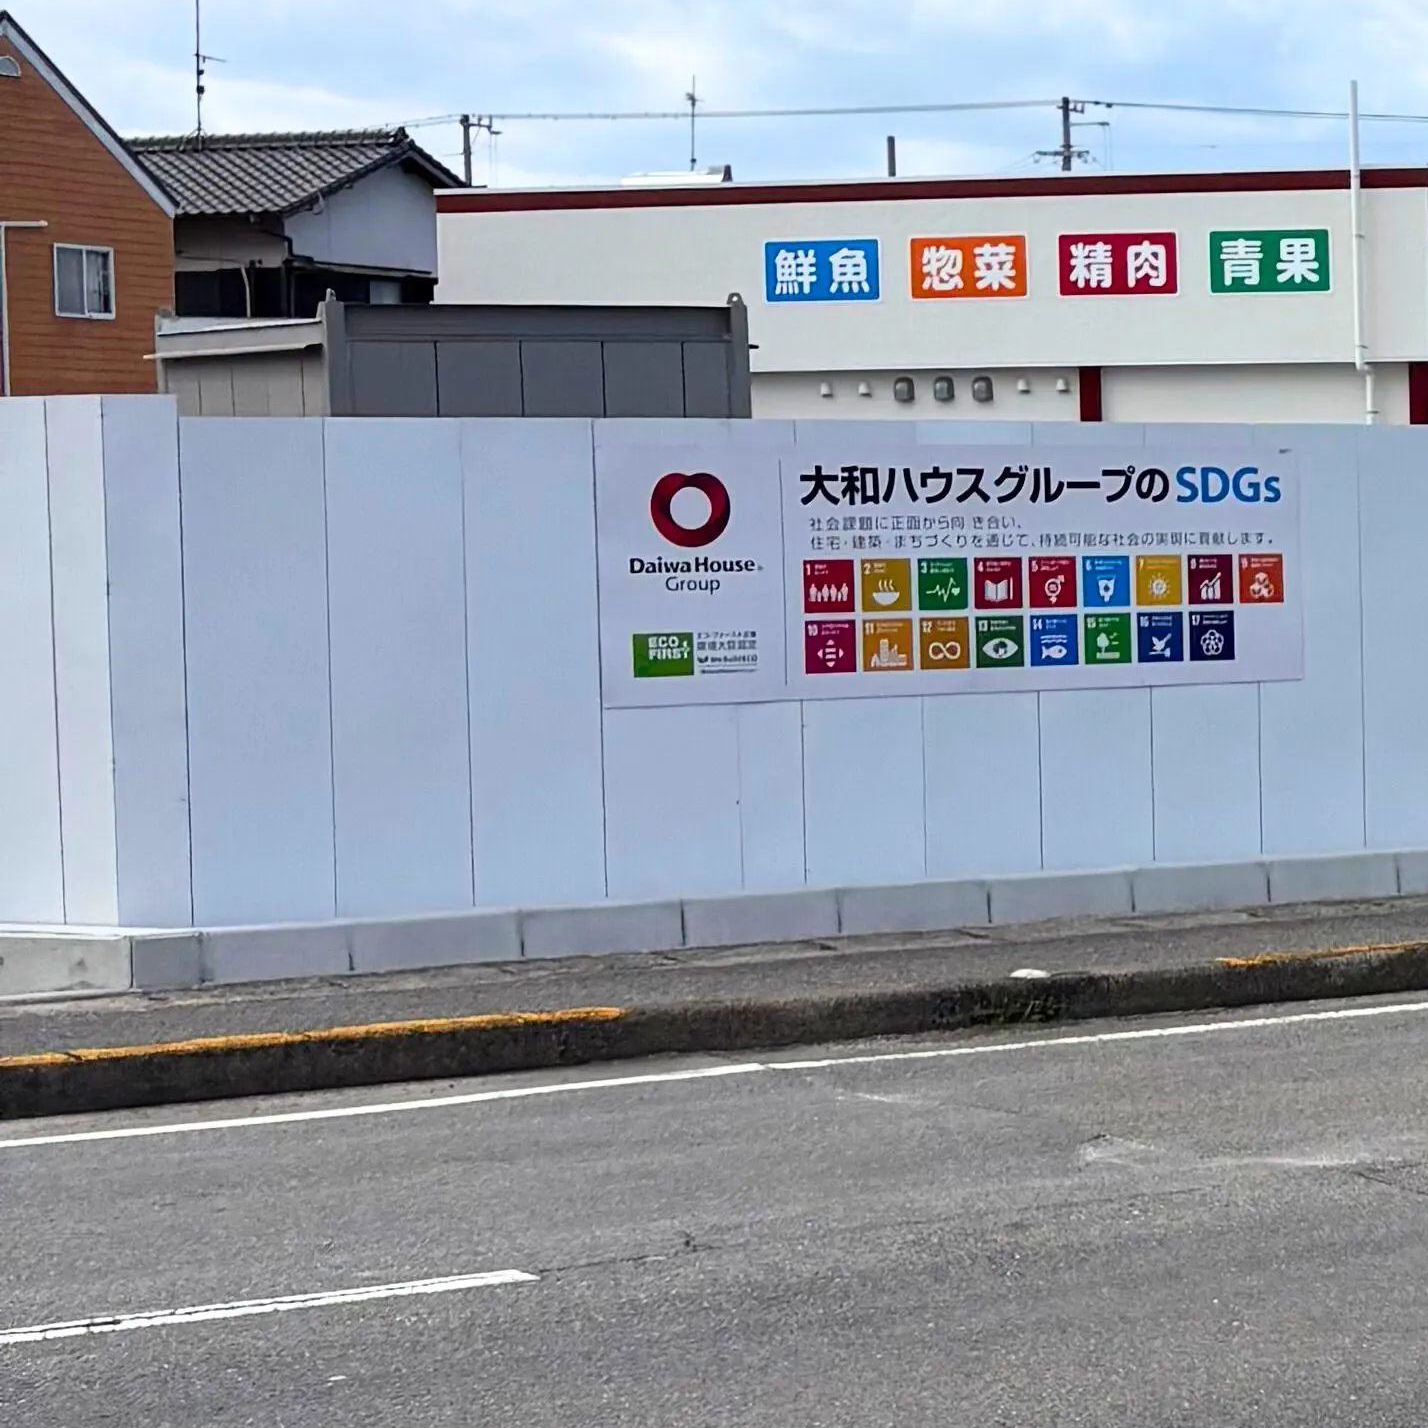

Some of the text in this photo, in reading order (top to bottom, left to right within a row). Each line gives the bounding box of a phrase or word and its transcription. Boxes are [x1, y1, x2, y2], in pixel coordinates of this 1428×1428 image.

[921, 243, 1016, 292] 惣菜
[1069, 240, 1166, 288] 精肉
[1219, 238, 1319, 285] 青果
[774, 248, 869, 294] 鮮魚
[629, 556, 756, 573] Daiwa House
[806, 564, 811, 575] 1
[864, 563, 871, 574] 2
[921, 562, 927, 574] 3
[977, 561, 984, 572] 4
[1032, 560, 1038, 571] 5
[665, 576, 721, 595] Group
[1033, 618, 1042, 629] 14
[648, 636, 679, 648] ECO
[648, 641, 690, 660] FIRST
